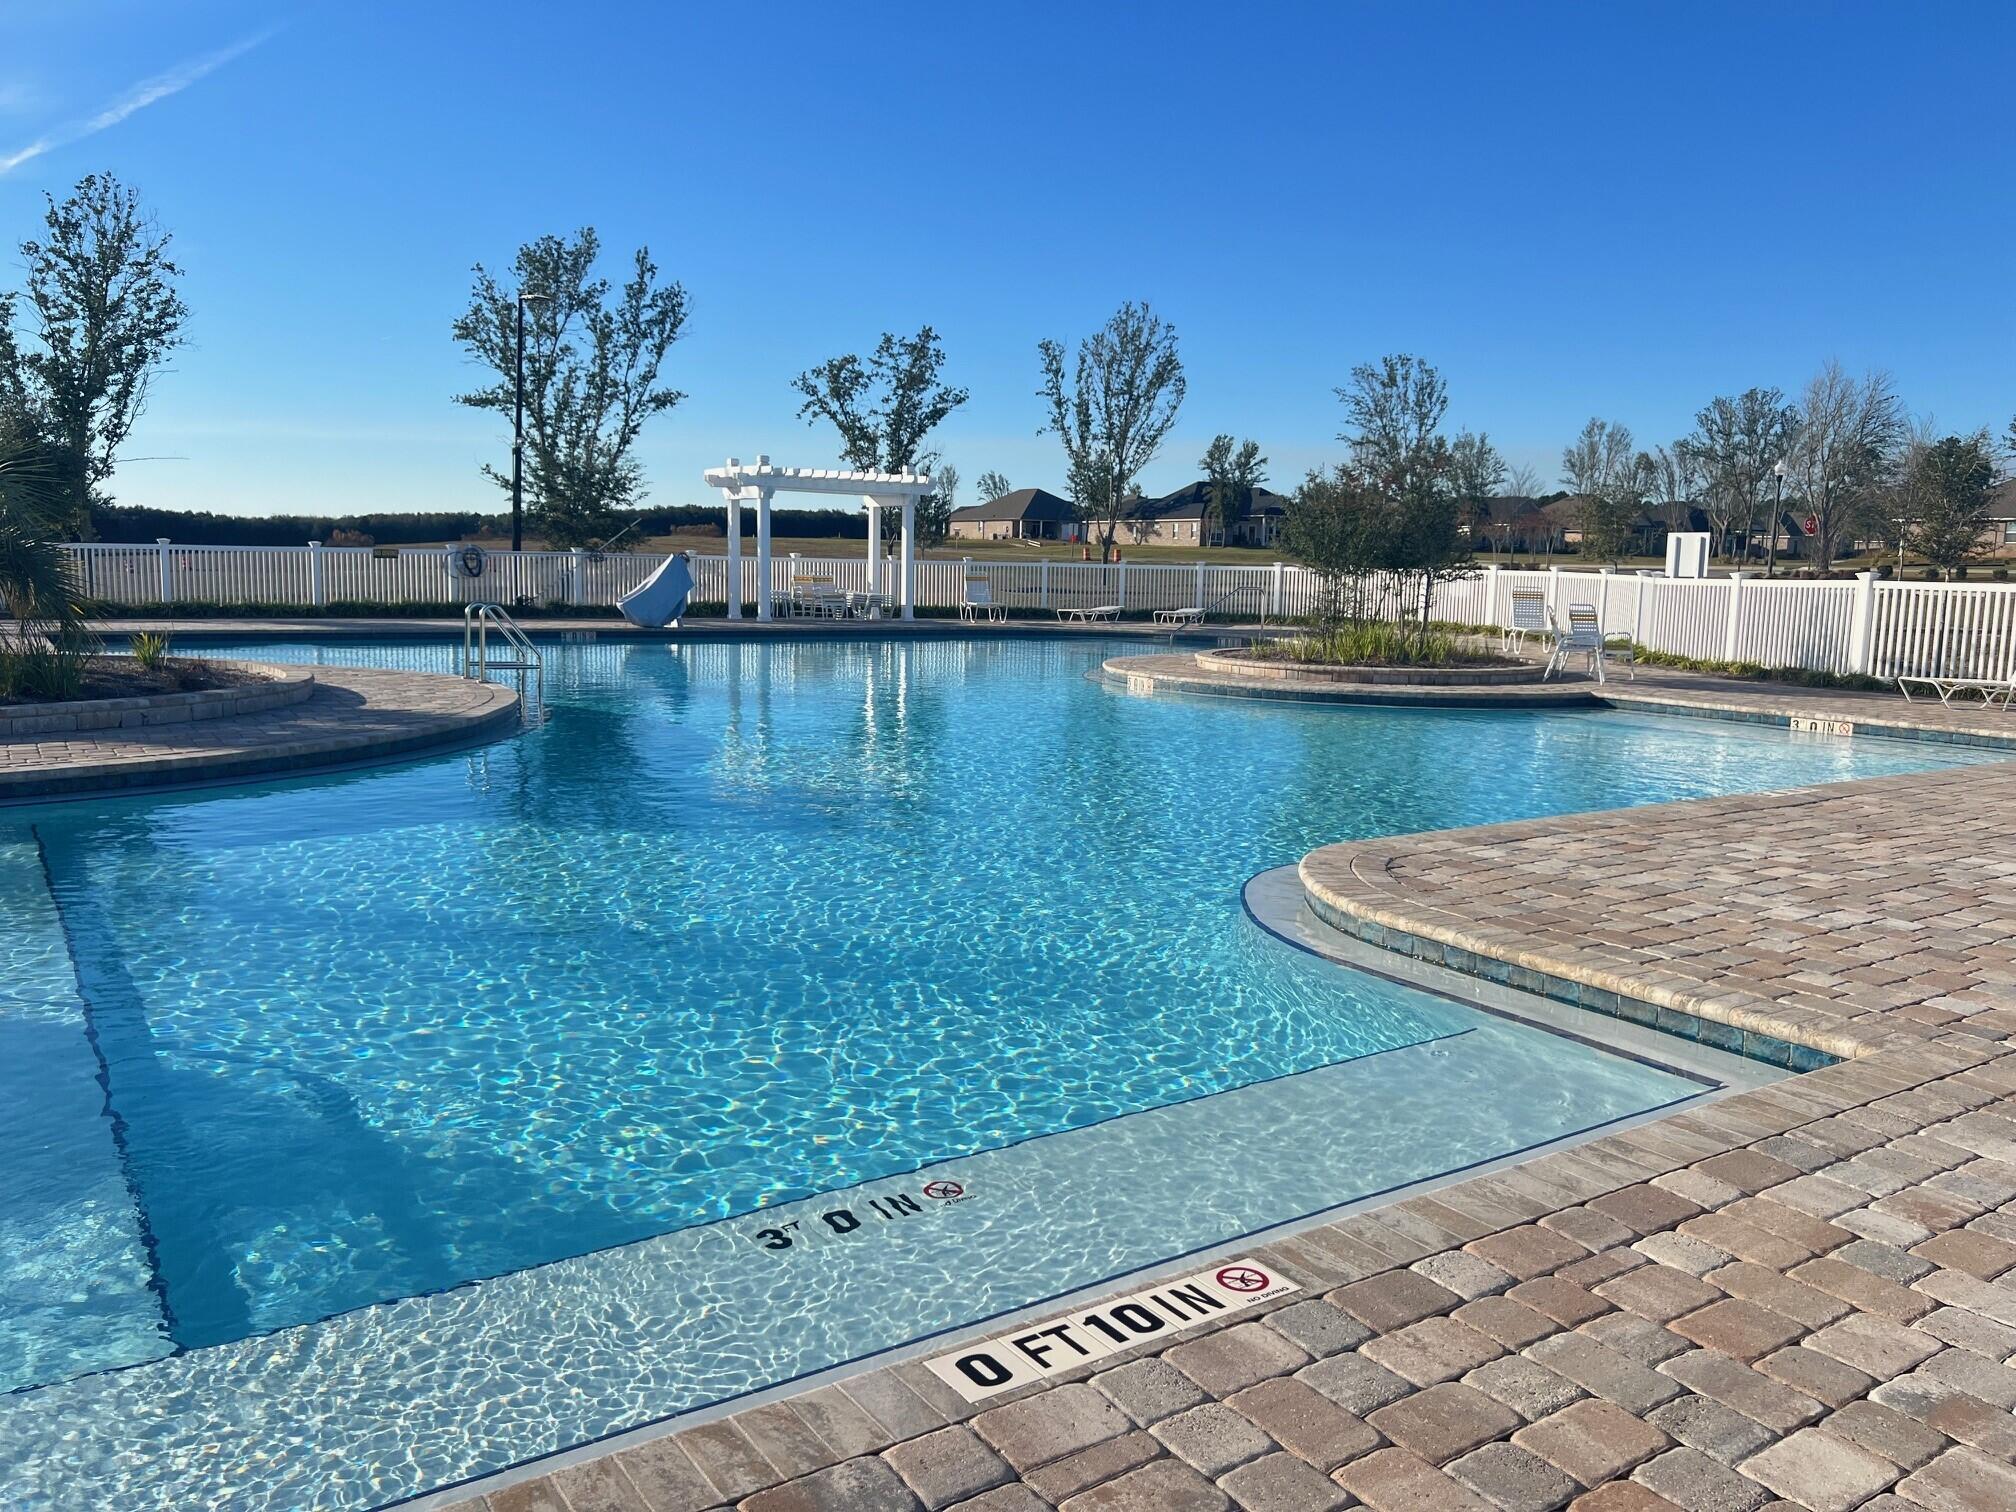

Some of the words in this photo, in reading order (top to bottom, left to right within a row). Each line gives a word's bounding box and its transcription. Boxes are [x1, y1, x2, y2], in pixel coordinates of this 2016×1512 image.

[1823, 721, 1835, 732] IN
[822, 1209, 862, 1234] 0
[868, 1193, 923, 1220] IN
[1261, 1286, 1290, 1298] DIVING
[954, 1352, 1014, 1388] 0
[1011, 1323, 1090, 1369] FT
[1082, 1303, 1166, 1344] 10
[1147, 1283, 1228, 1322] IN
